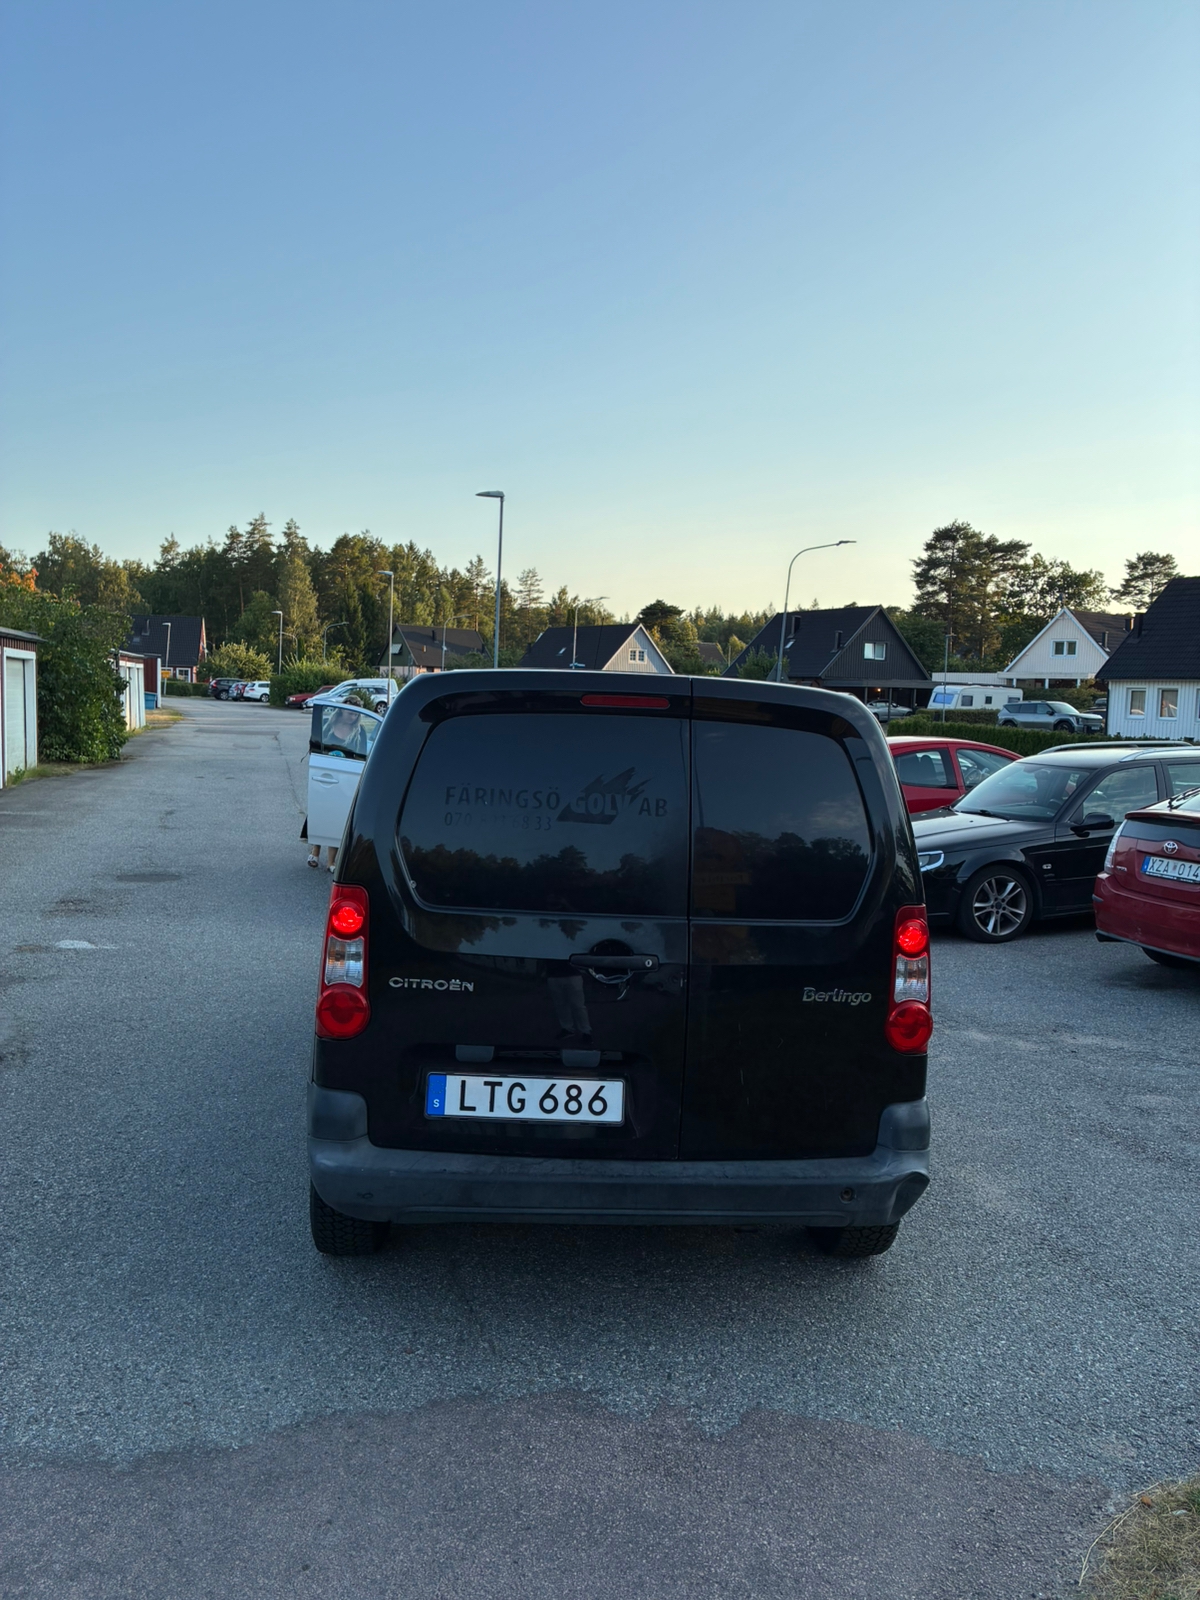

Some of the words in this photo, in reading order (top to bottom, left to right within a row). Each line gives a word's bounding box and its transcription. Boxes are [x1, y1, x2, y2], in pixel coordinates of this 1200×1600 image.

[444, 782, 561, 811] FÄRINGSÖ
[638, 797, 669, 818] AB
[533, 816, 552, 831] 33
[1148, 858, 1170, 874] XZA
[388, 976, 475, 992] CITROËN
[801, 987, 873, 1006] Berlingo
[433, 1098, 440, 1108] S
[459, 1079, 527, 1113] LTG
[538, 1083, 608, 1116] 686
